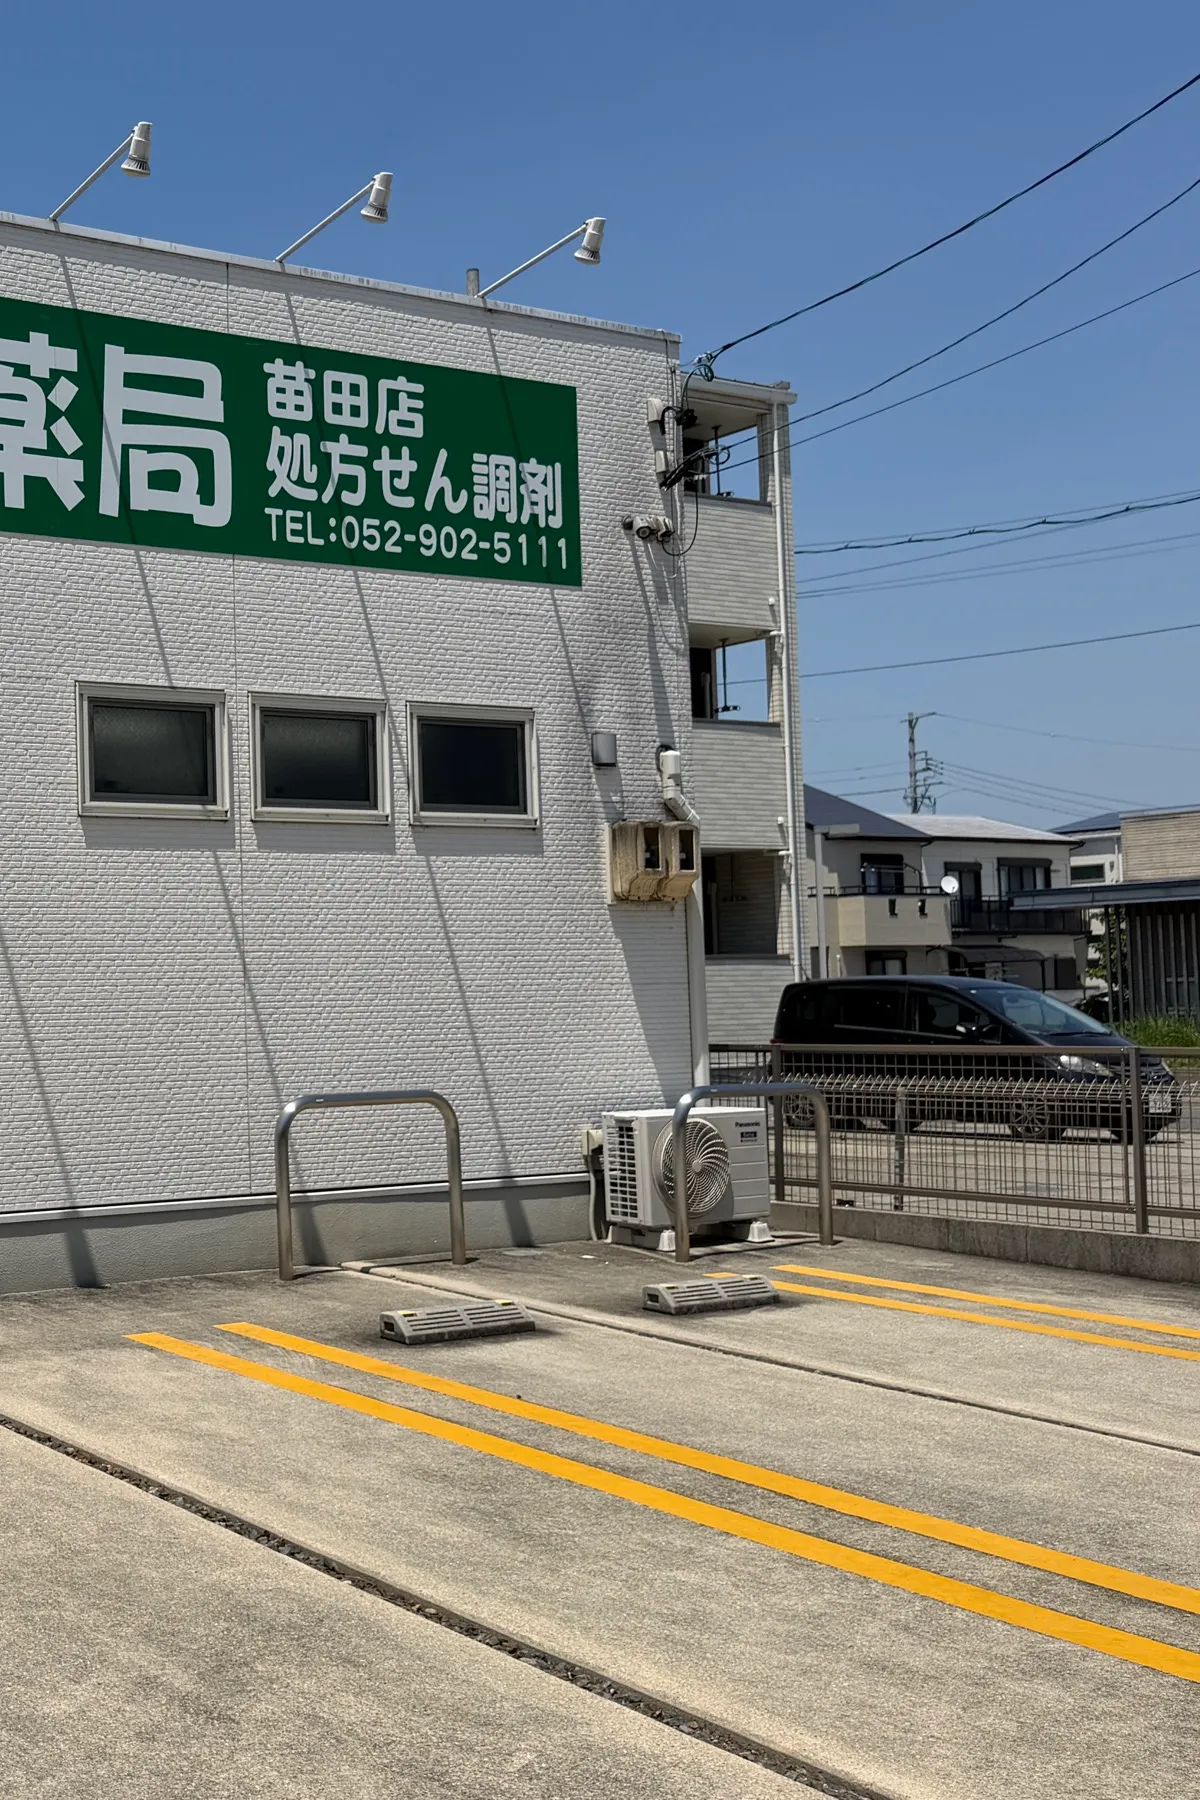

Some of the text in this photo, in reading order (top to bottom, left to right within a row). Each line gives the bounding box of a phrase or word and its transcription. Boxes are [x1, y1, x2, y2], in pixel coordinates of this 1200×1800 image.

[263, 358, 425, 438] 苗田店
[265, 426, 563, 529] 処方せん調剤
[264, 507, 567, 570] TEL:052-902-5111
